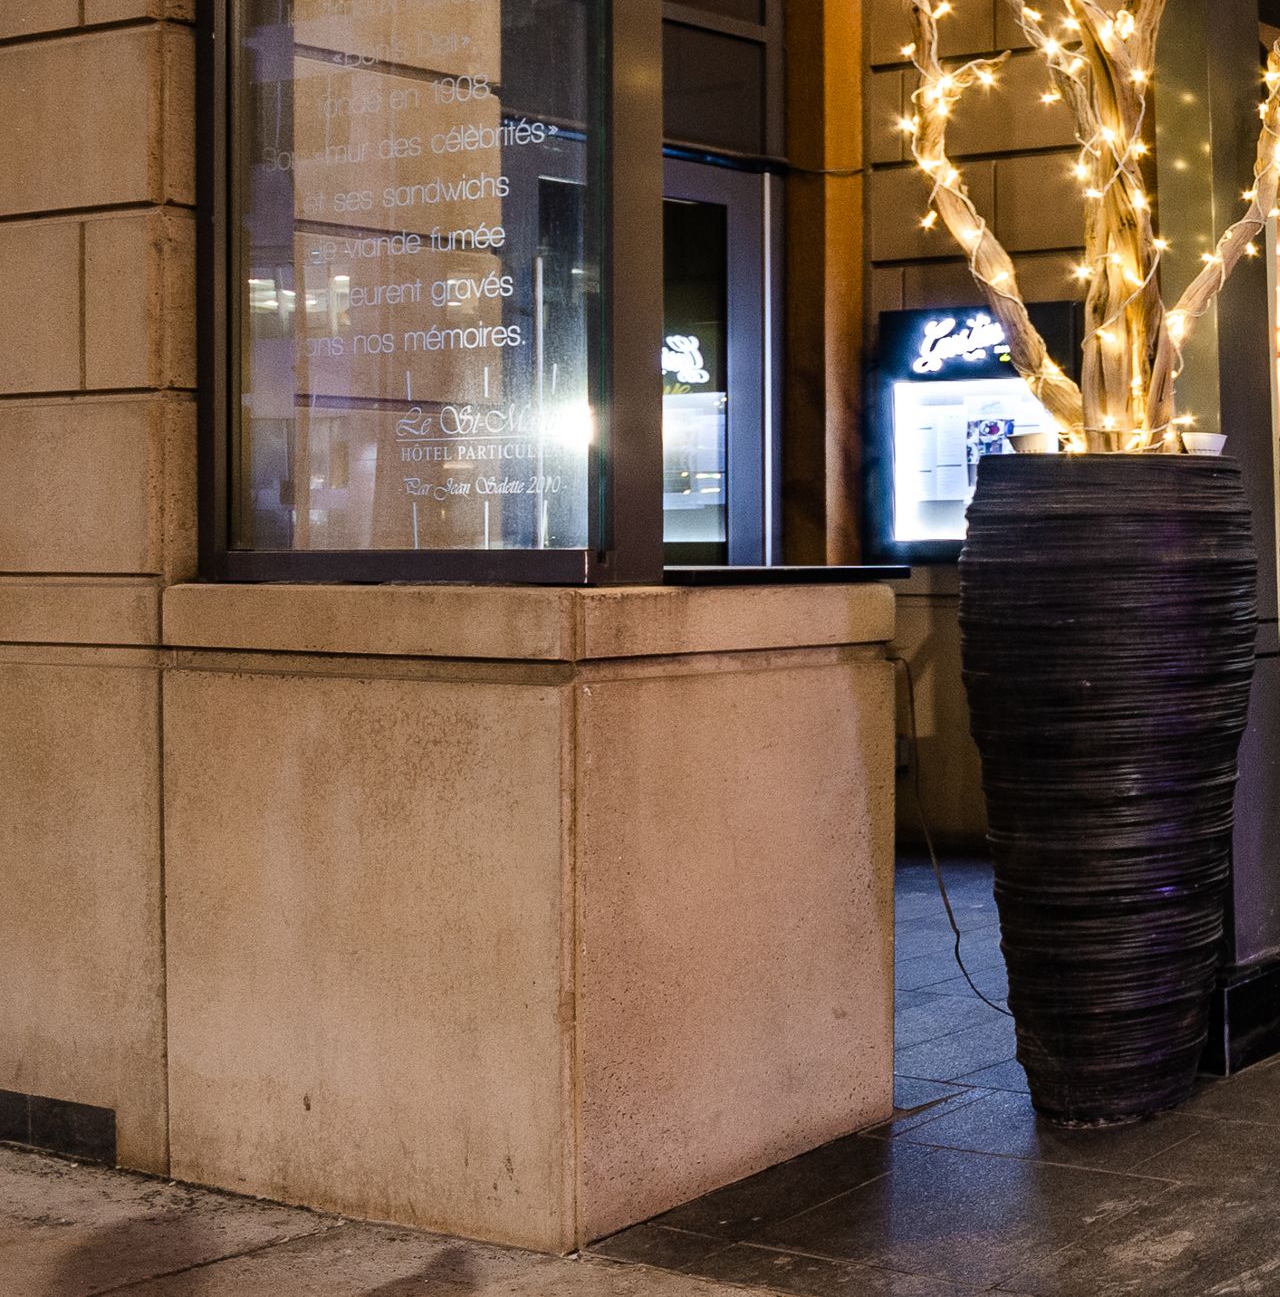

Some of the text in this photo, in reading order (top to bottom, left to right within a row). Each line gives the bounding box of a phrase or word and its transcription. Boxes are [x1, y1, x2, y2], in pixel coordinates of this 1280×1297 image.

[432, 73, 490, 104] 1908
[380, 131, 420, 159] des
[334, 190, 374, 213] ses
[383, 172, 510, 208] sandwichs
[344, 228, 421, 259] viande
[430, 221, 507, 252] fumée
[430, 270, 514, 308] gravés
[352, 333, 395, 355] nos
[403, 319, 526, 353] mémoires.
[396, 406, 432, 437] Le
[401, 443, 453, 462] HÔTEL
